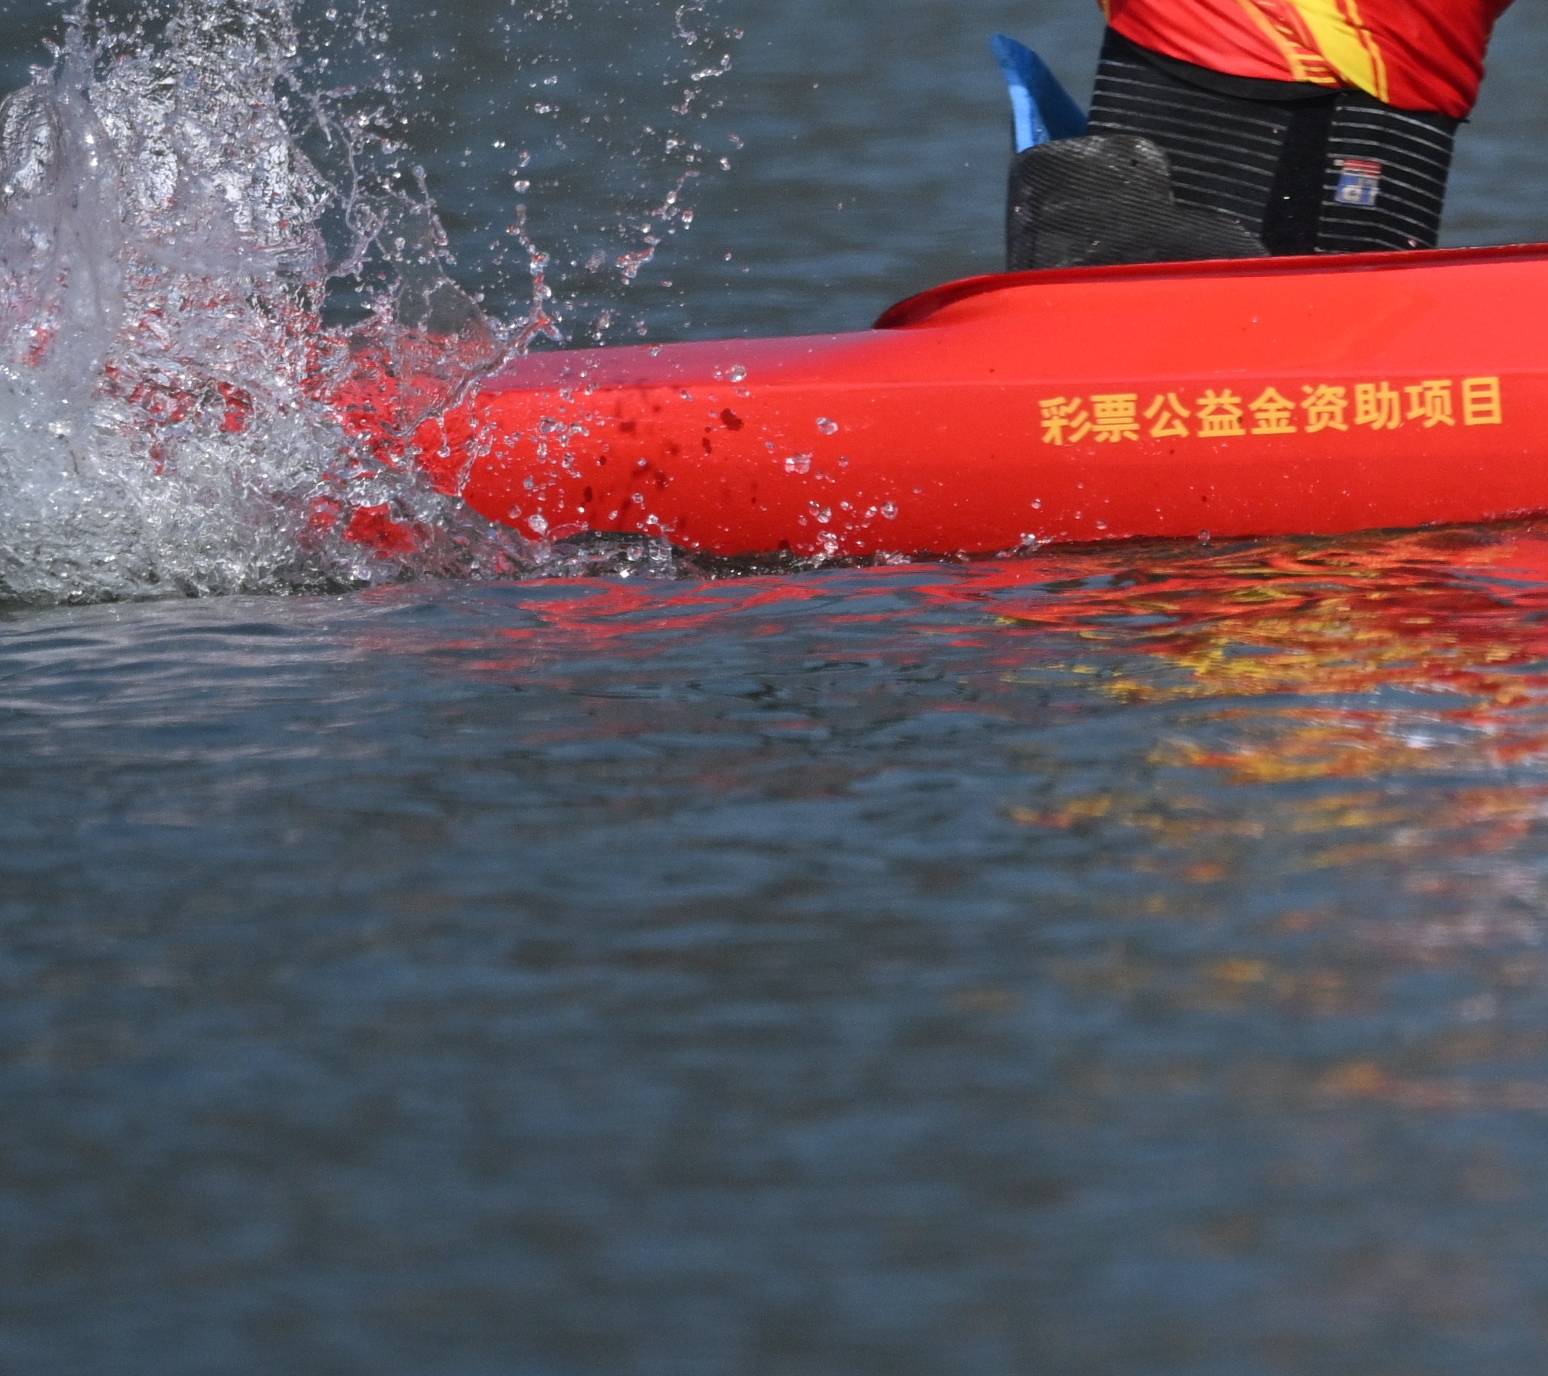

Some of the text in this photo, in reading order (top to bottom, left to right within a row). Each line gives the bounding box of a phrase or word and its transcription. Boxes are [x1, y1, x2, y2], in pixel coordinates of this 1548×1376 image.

[1038, 376, 1503, 446] 彩票公益金资助项目
